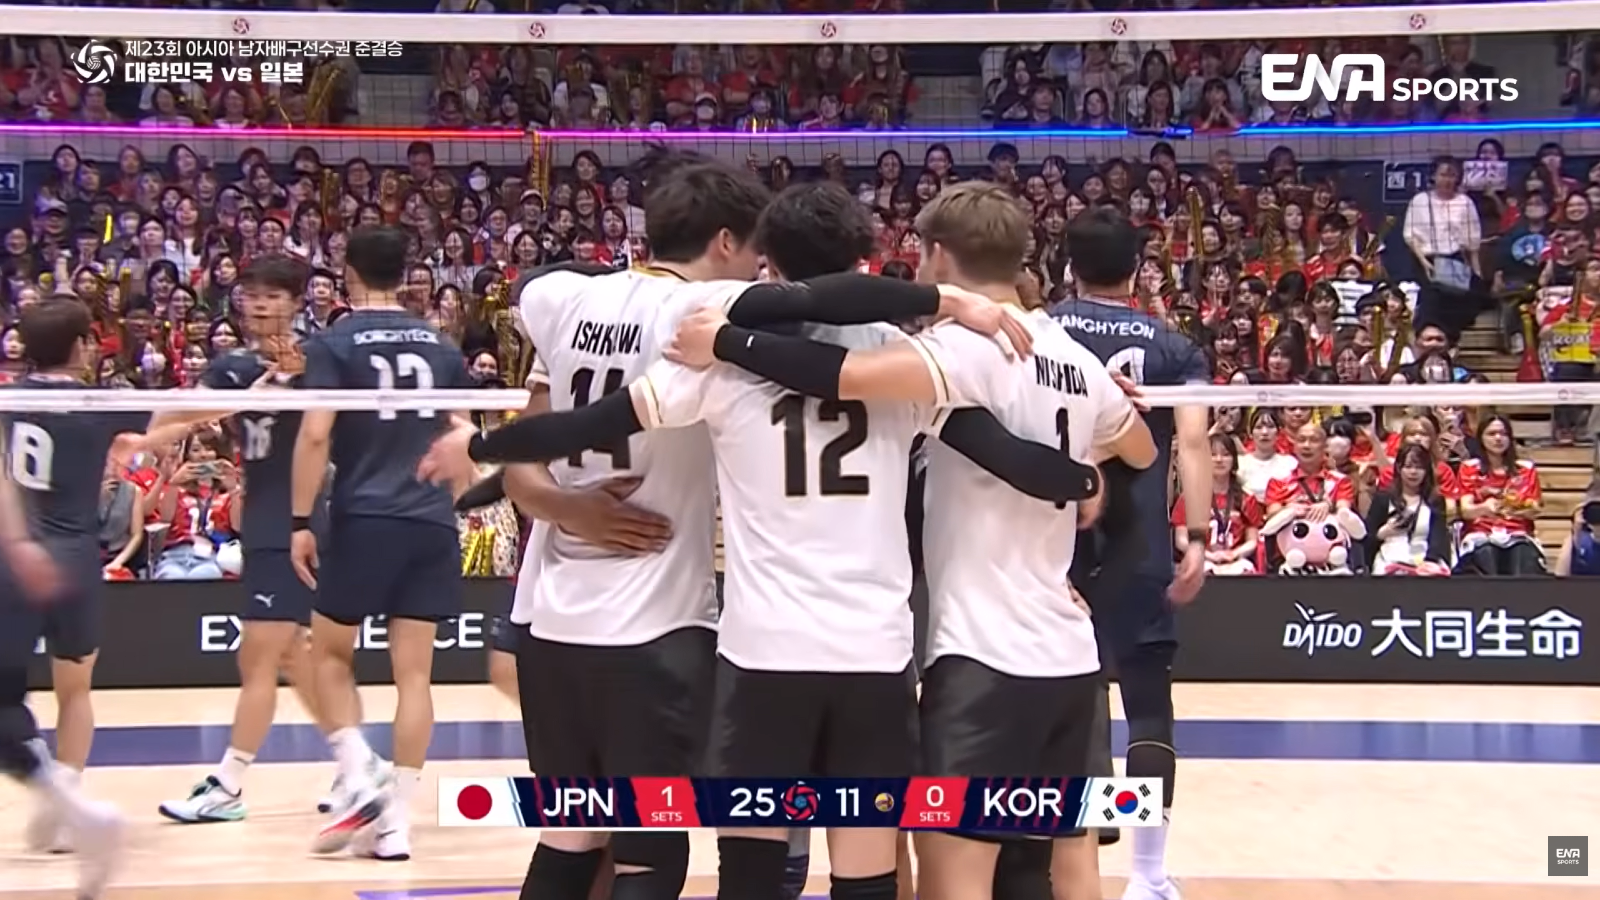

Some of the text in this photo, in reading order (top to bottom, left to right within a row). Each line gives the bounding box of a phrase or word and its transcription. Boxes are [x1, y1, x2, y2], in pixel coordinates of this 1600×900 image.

[771, 393, 869, 497] 12
[1282, 608, 1583, 659] DAIDO 大同生命
